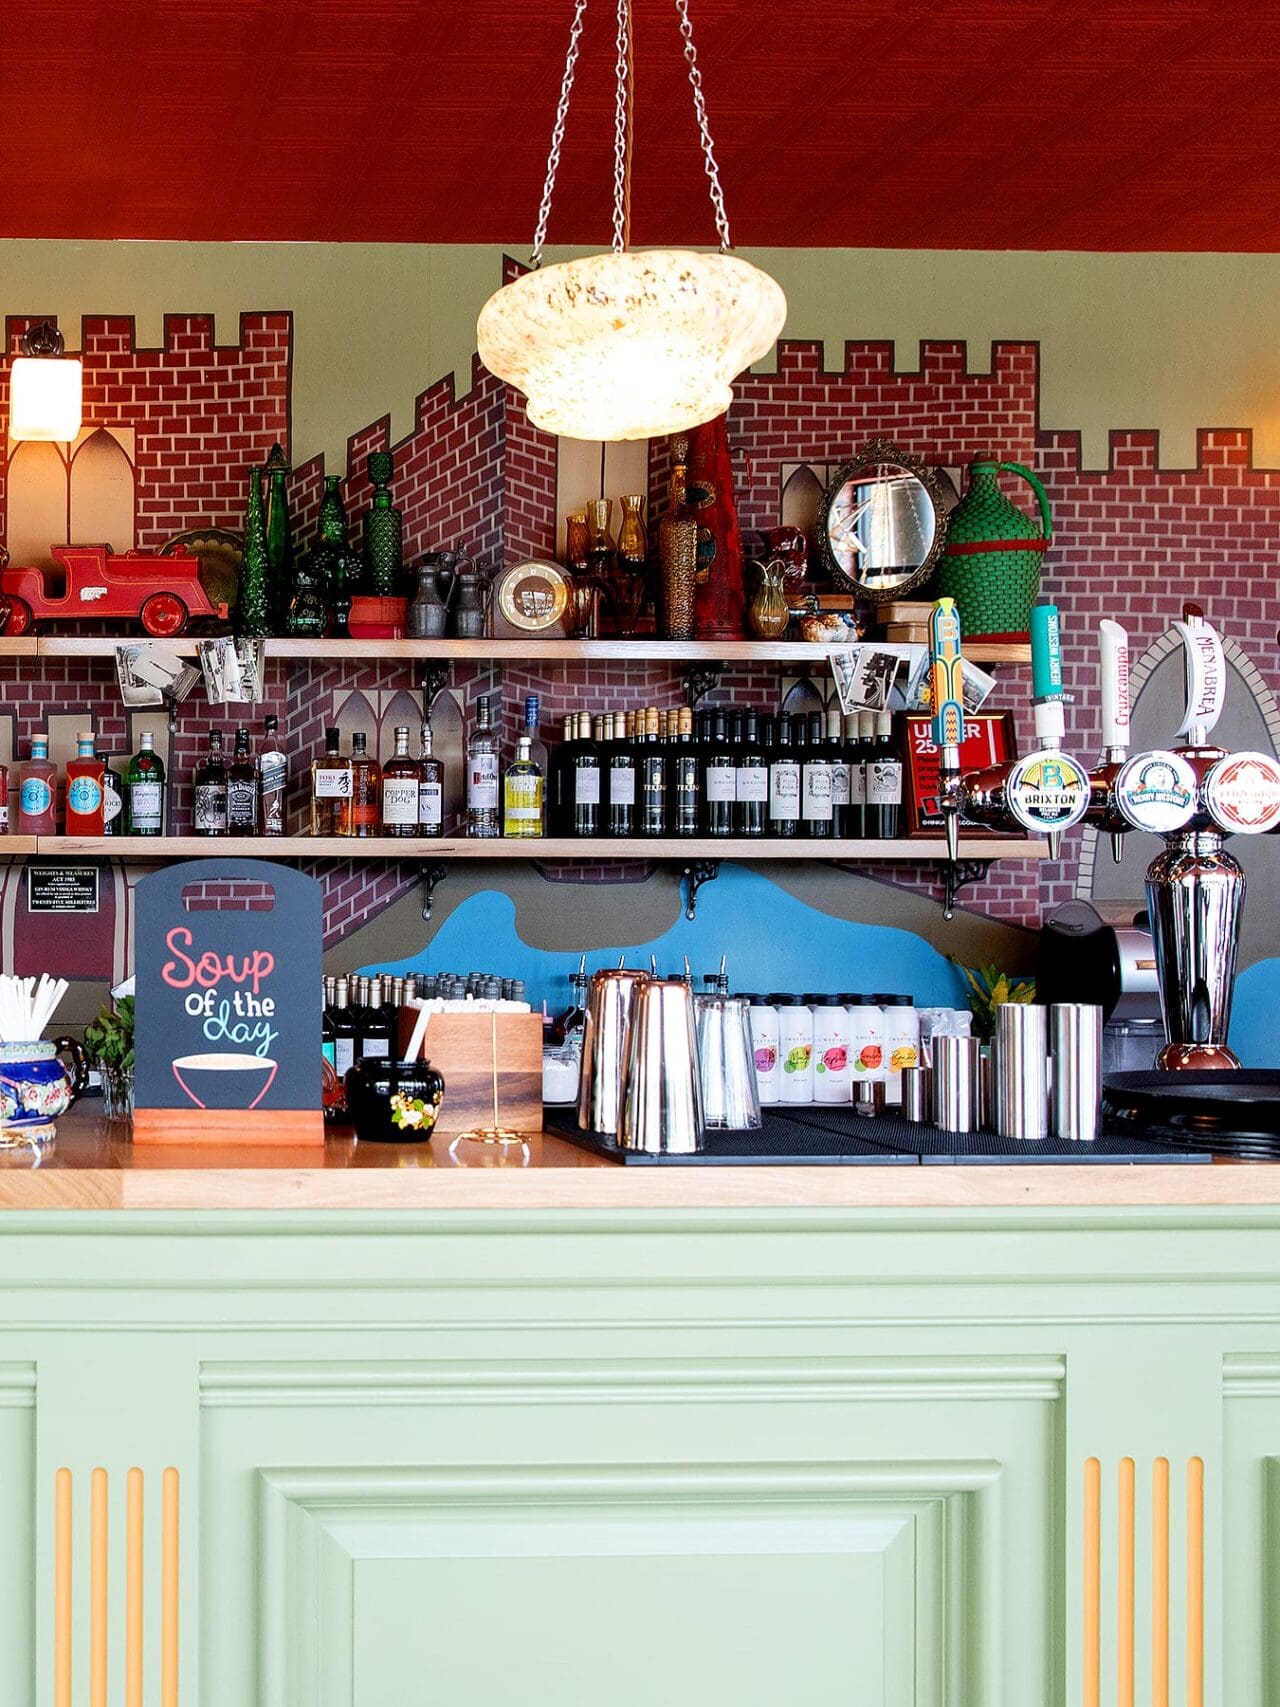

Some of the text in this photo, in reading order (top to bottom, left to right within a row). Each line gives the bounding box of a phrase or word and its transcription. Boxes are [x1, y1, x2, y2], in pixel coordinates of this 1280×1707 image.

[1047, 615, 1061, 686] HENRY WESTONS
[1195, 636, 1218, 717] MENABREA
[1114, 646, 1129, 727] Cruzcampo
[915, 739, 938, 754] 25
[384, 789, 417, 799] COPPER
[1025, 794, 1077, 805] BRIXTON
[161, 926, 275, 995] Soup
[203, 999, 280, 1058] day
[233, 990, 276, 1018] the
